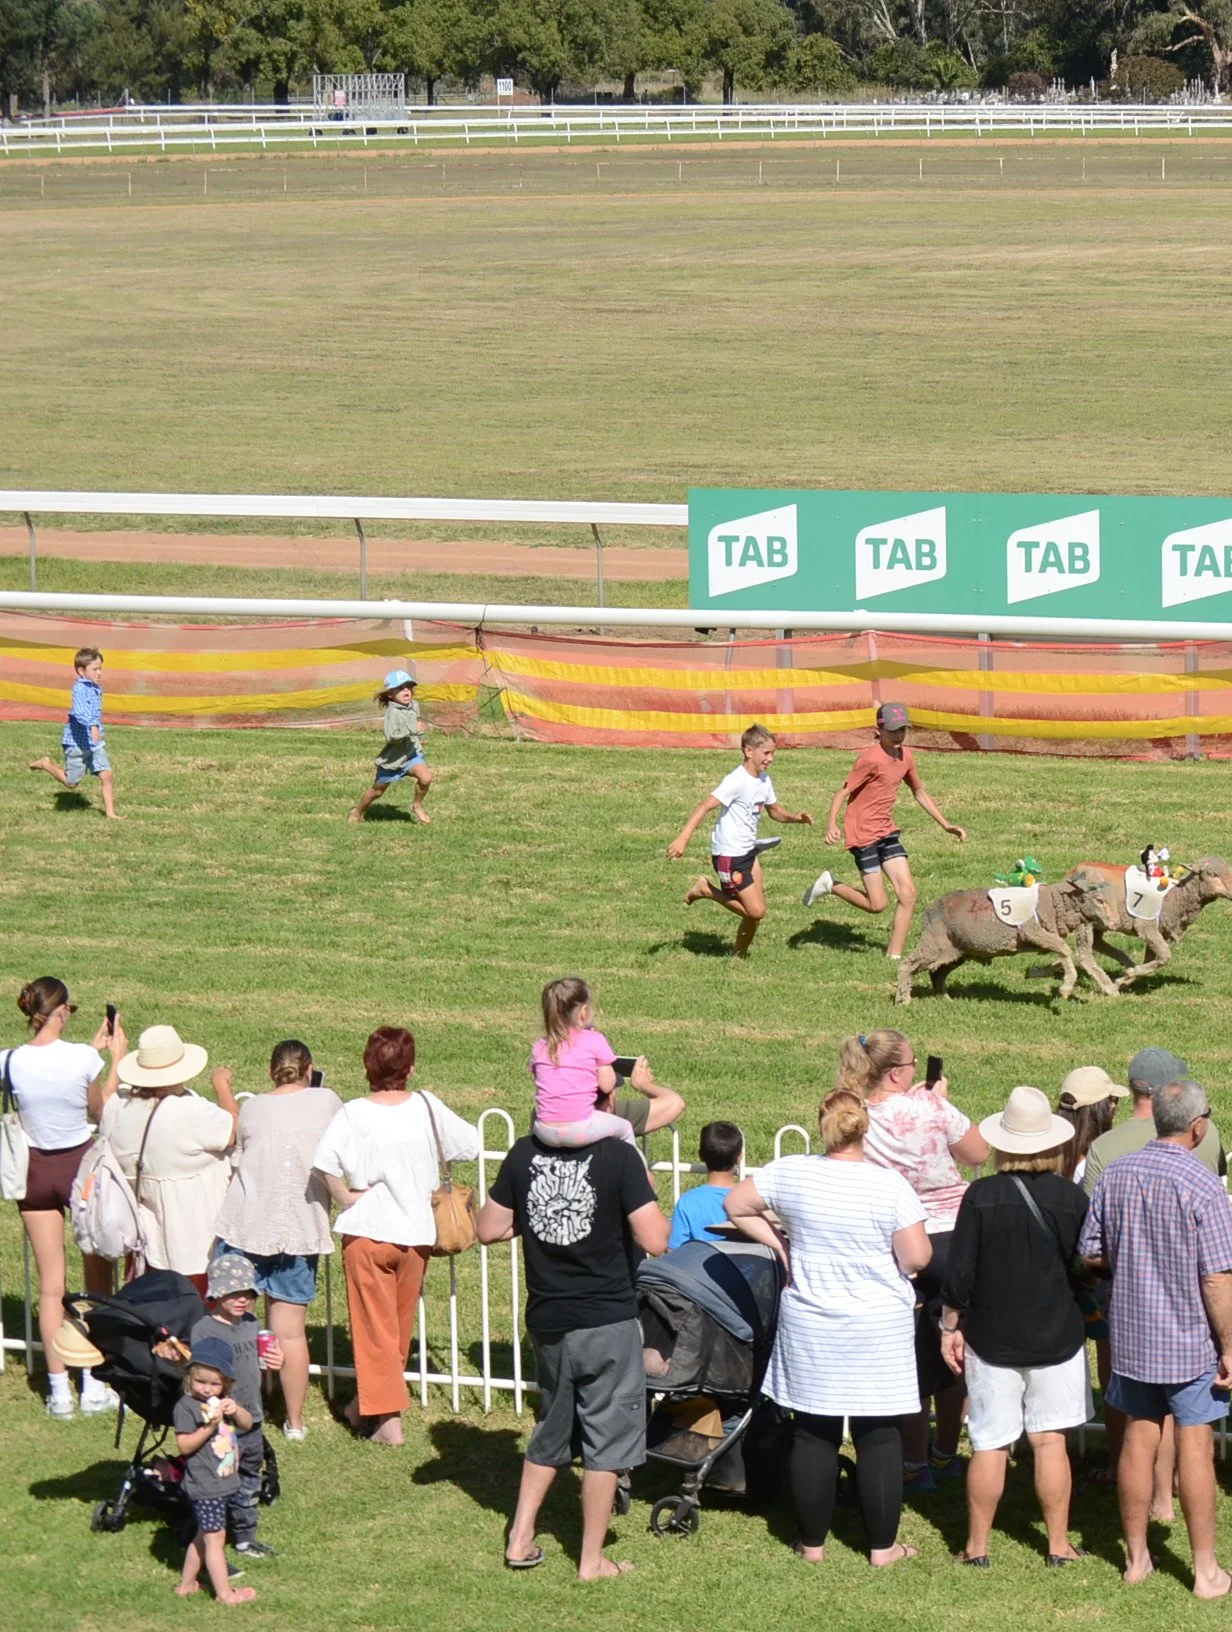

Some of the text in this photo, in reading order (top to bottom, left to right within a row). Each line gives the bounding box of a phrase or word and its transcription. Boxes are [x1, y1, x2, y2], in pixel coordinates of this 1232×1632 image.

[498, 80, 512, 92] 1100
[717, 534, 789, 568] TAB
[864, 537, 938, 571] TAB
[1016, 540, 1091, 575] TAB
[1000, 898, 1012, 917] 5
[1132, 890, 1145, 909] 7
